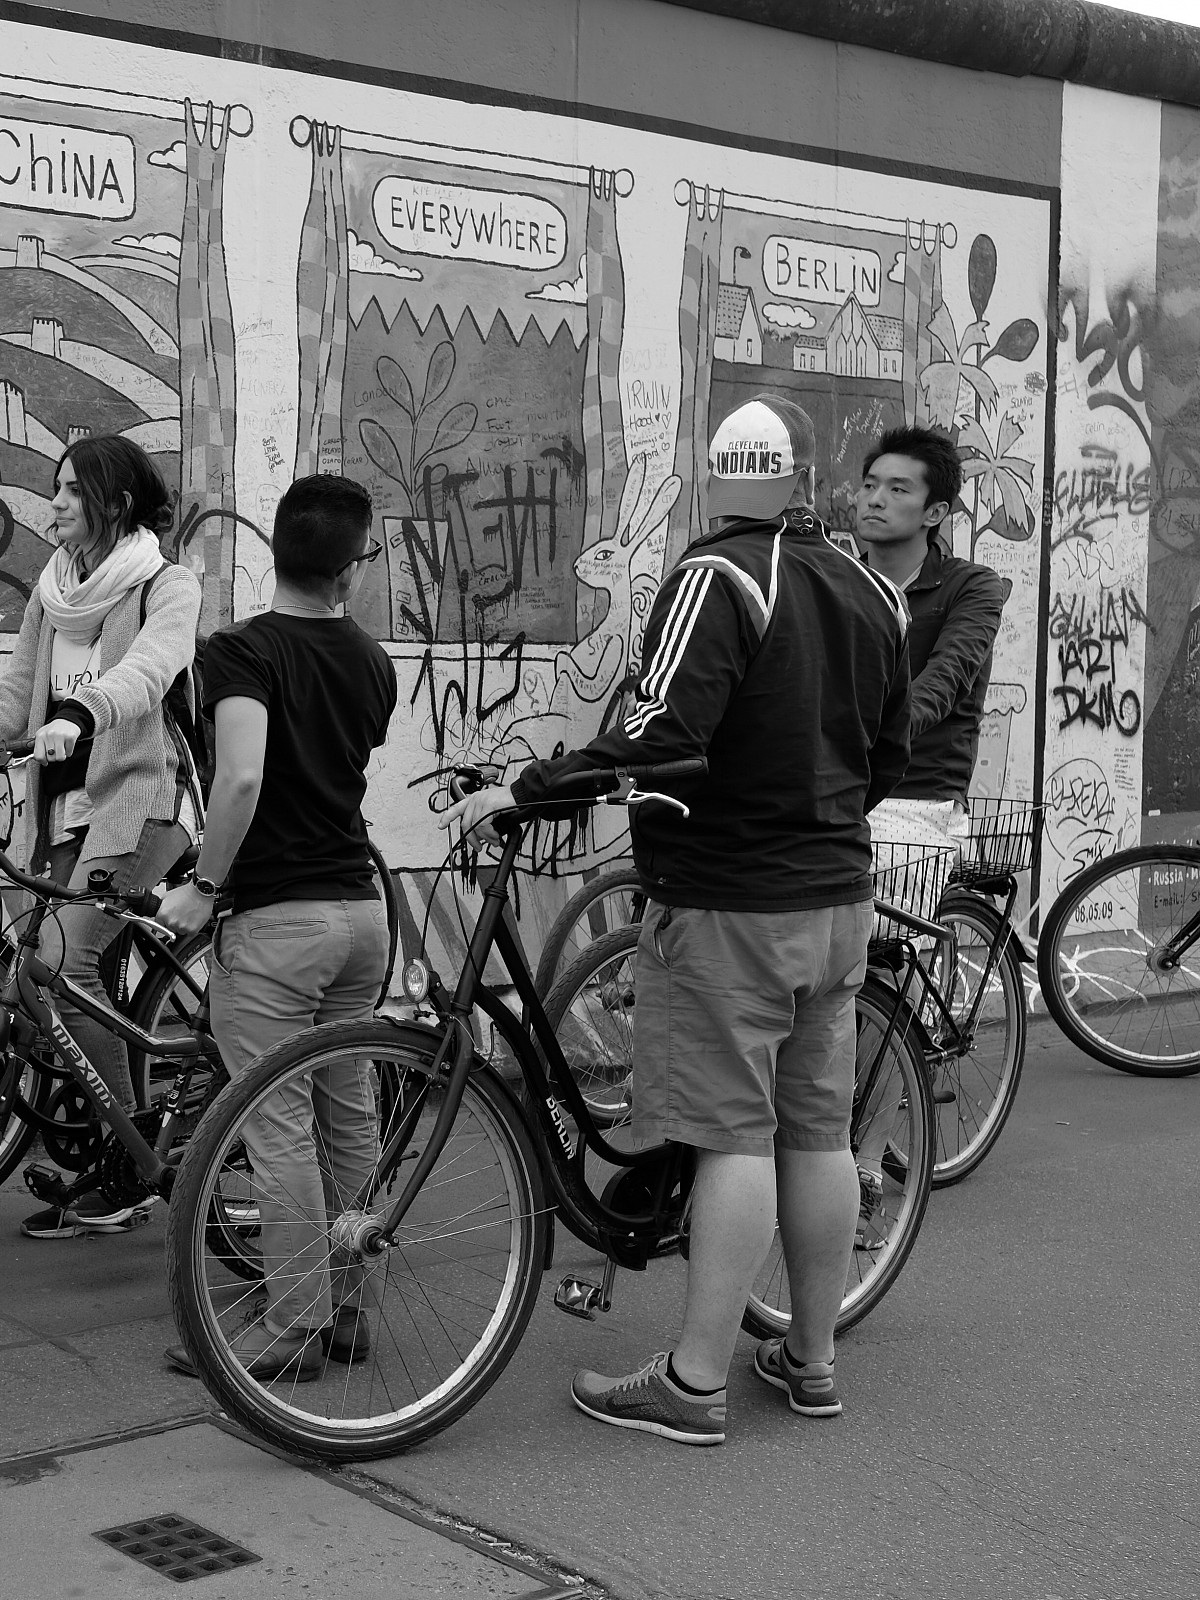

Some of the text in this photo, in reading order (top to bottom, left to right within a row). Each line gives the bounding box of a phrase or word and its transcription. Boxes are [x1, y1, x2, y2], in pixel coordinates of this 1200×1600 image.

[728, 440, 769, 451] CLEVELAND
[716, 451, 782, 475] INDIANS
[546, 1095, 576, 1160] BERLIN
